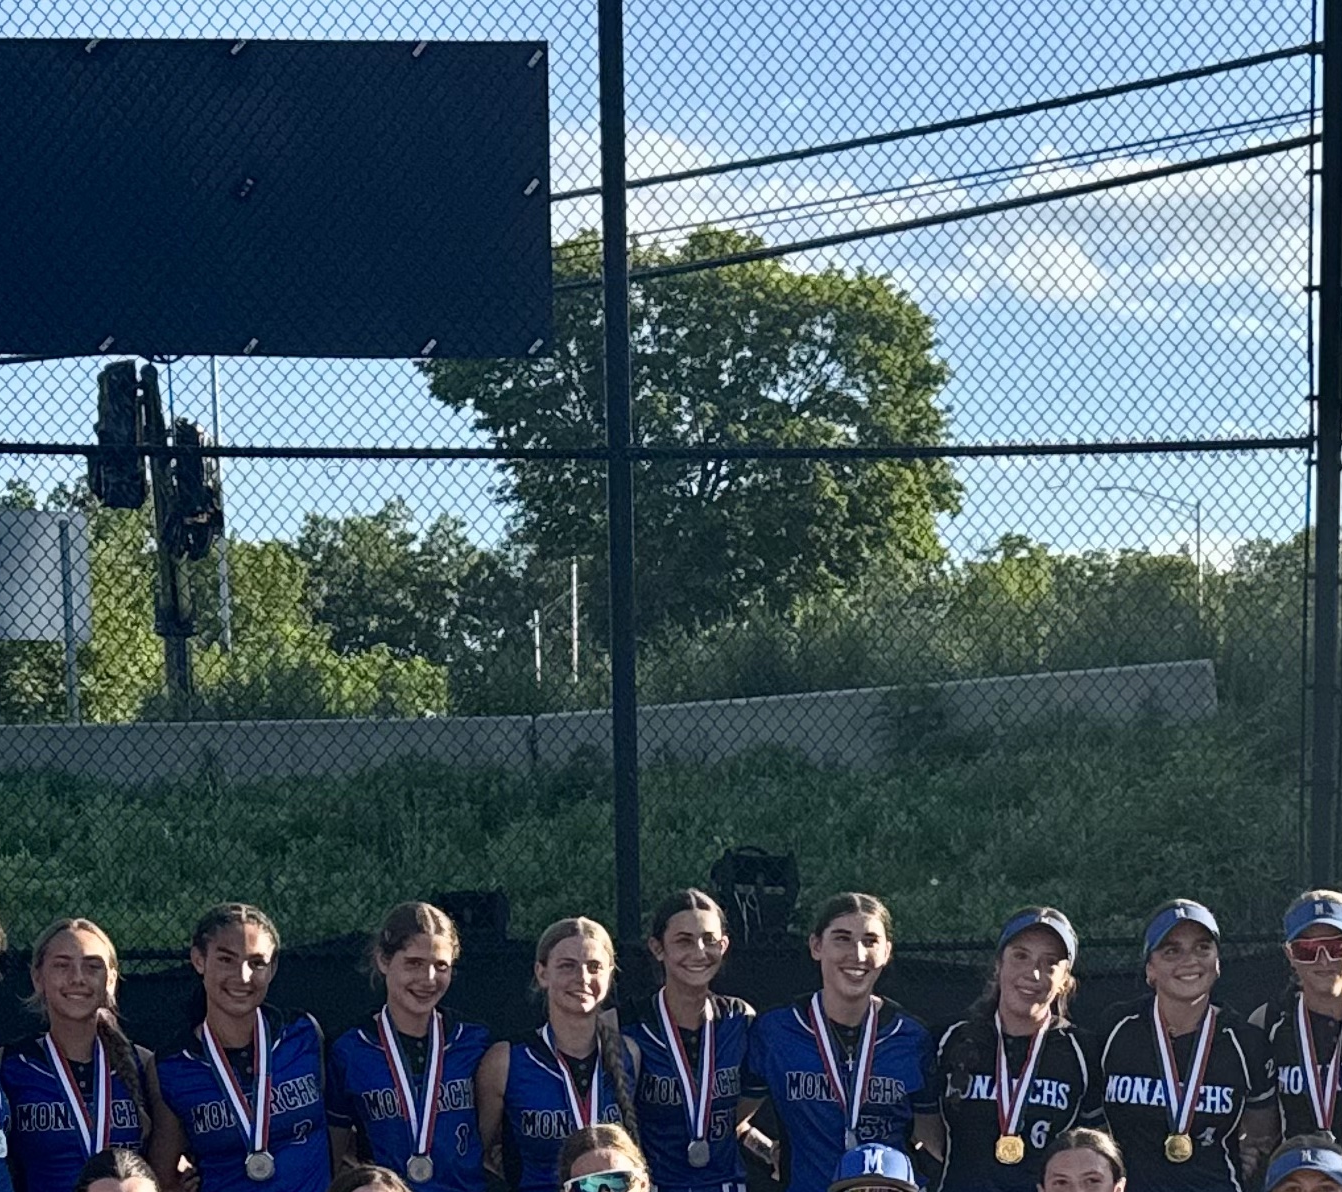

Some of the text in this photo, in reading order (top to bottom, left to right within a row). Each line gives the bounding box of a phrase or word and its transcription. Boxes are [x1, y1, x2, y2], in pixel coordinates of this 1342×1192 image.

[785, 1070, 907, 1105] MONCHS
[1104, 1075, 1234, 1114] MONACHS
[16, 1098, 141, 1132] MONCH
[1030, 1119, 1051, 1149] 6
[862, 1149, 885, 1175] M
